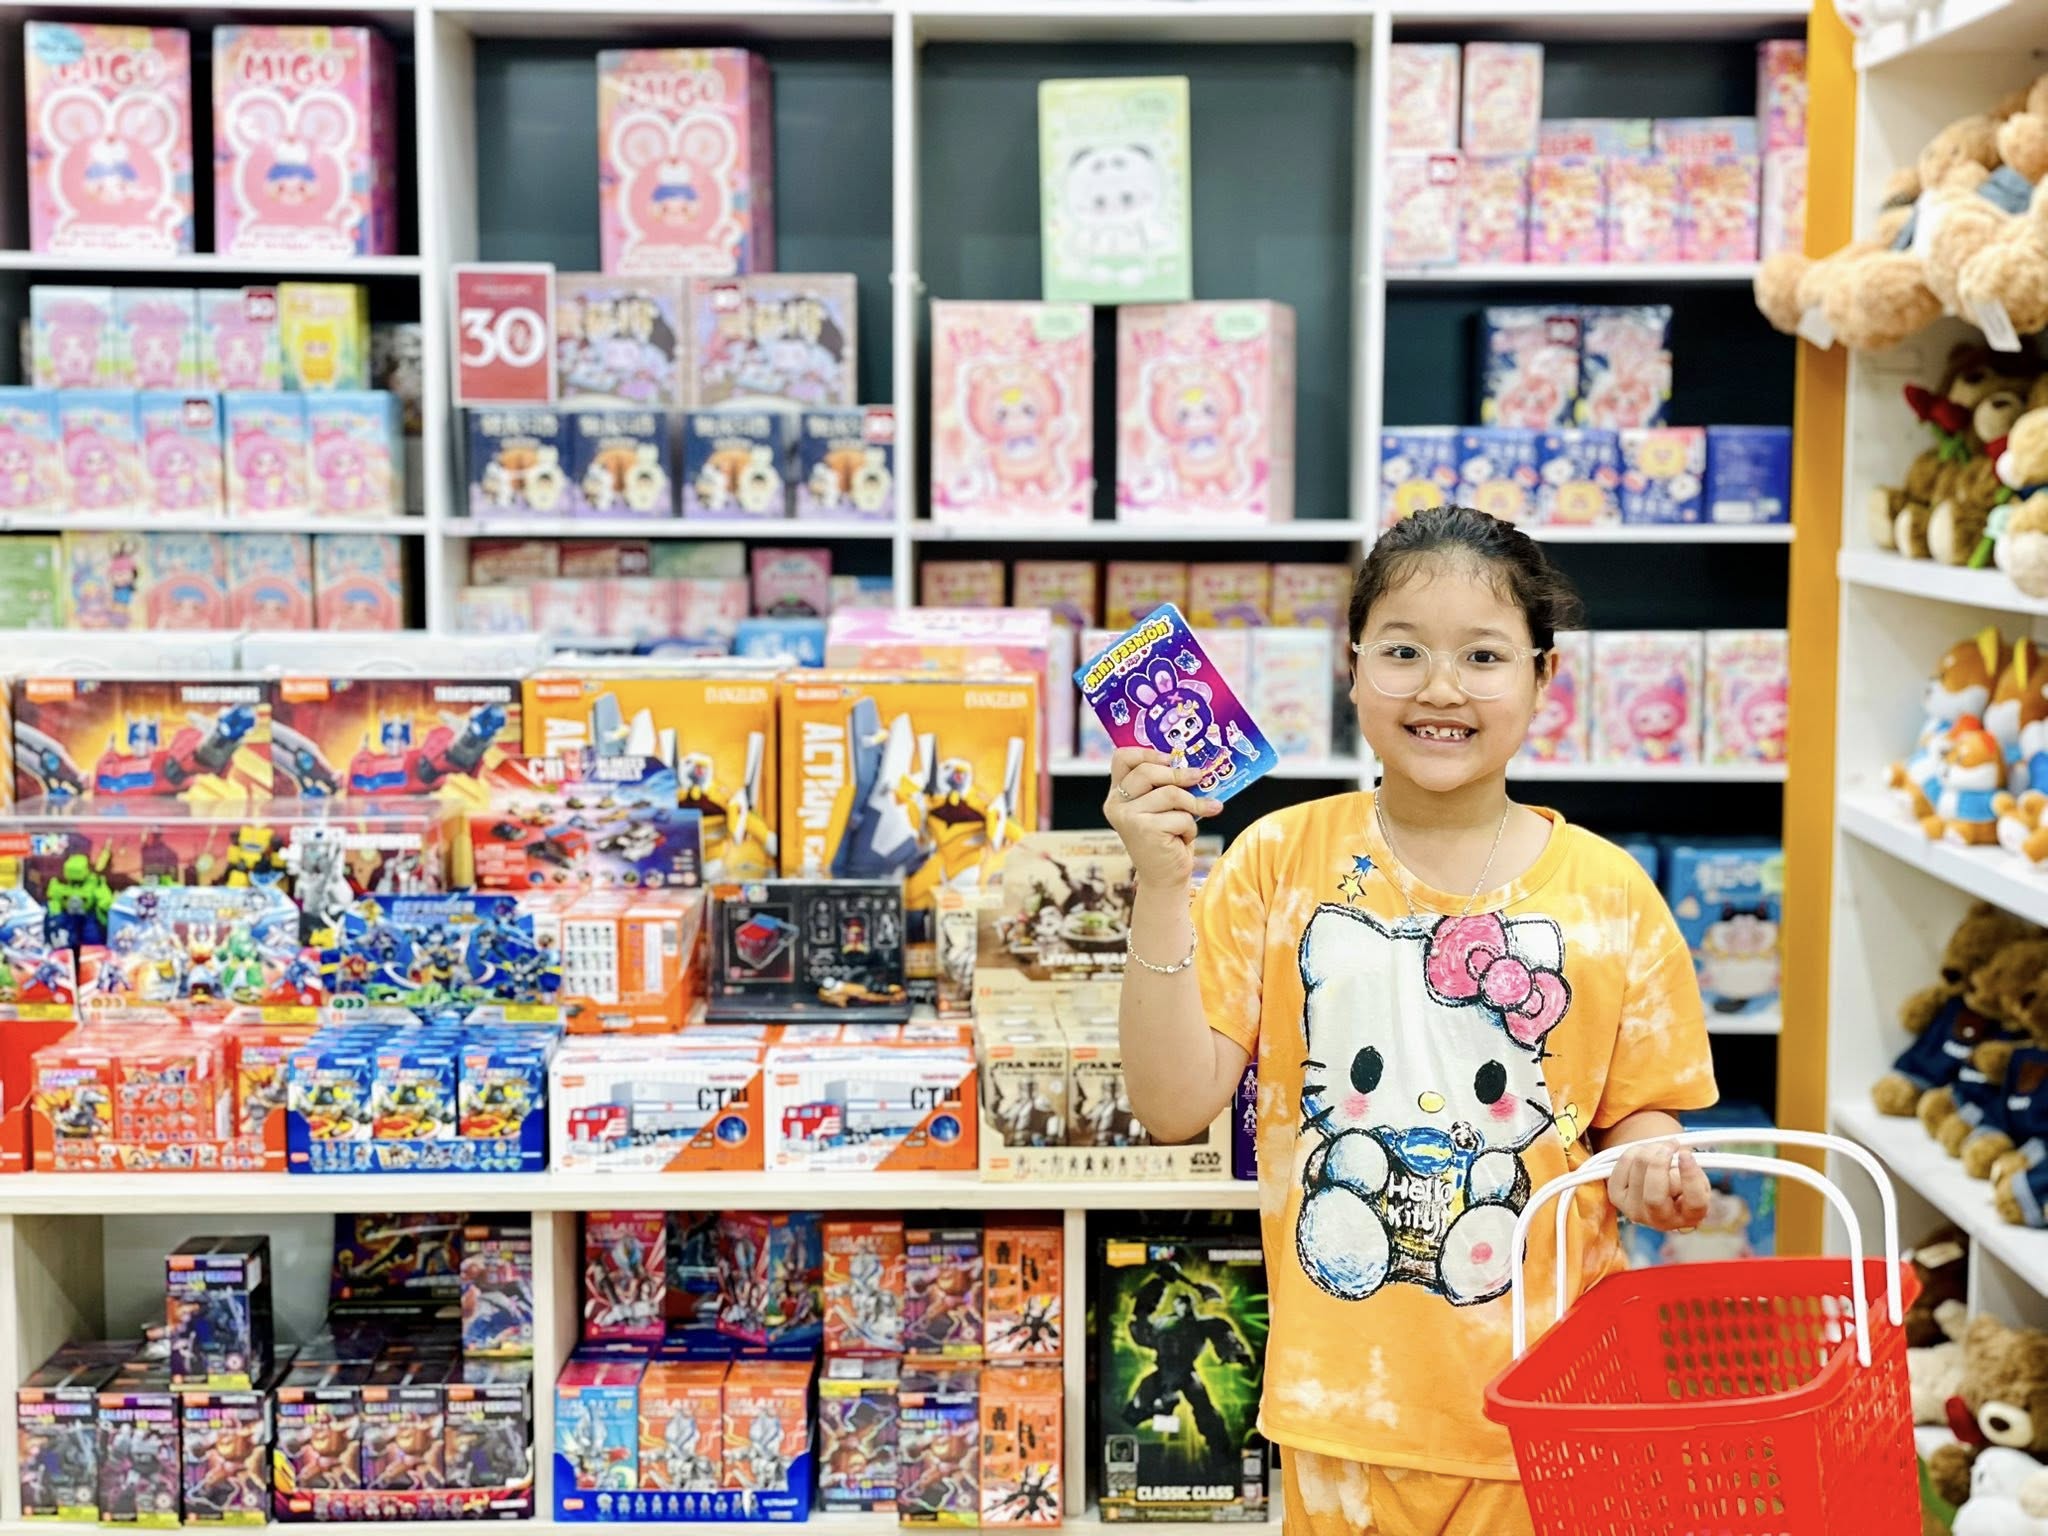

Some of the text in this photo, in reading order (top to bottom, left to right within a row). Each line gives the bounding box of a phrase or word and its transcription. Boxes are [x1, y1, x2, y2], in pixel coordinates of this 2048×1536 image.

[461, 307, 546, 368] 30
[1388, 1171, 1453, 1204] Hello
[1136, 1485, 1235, 1501] CLASSIC CLASS
